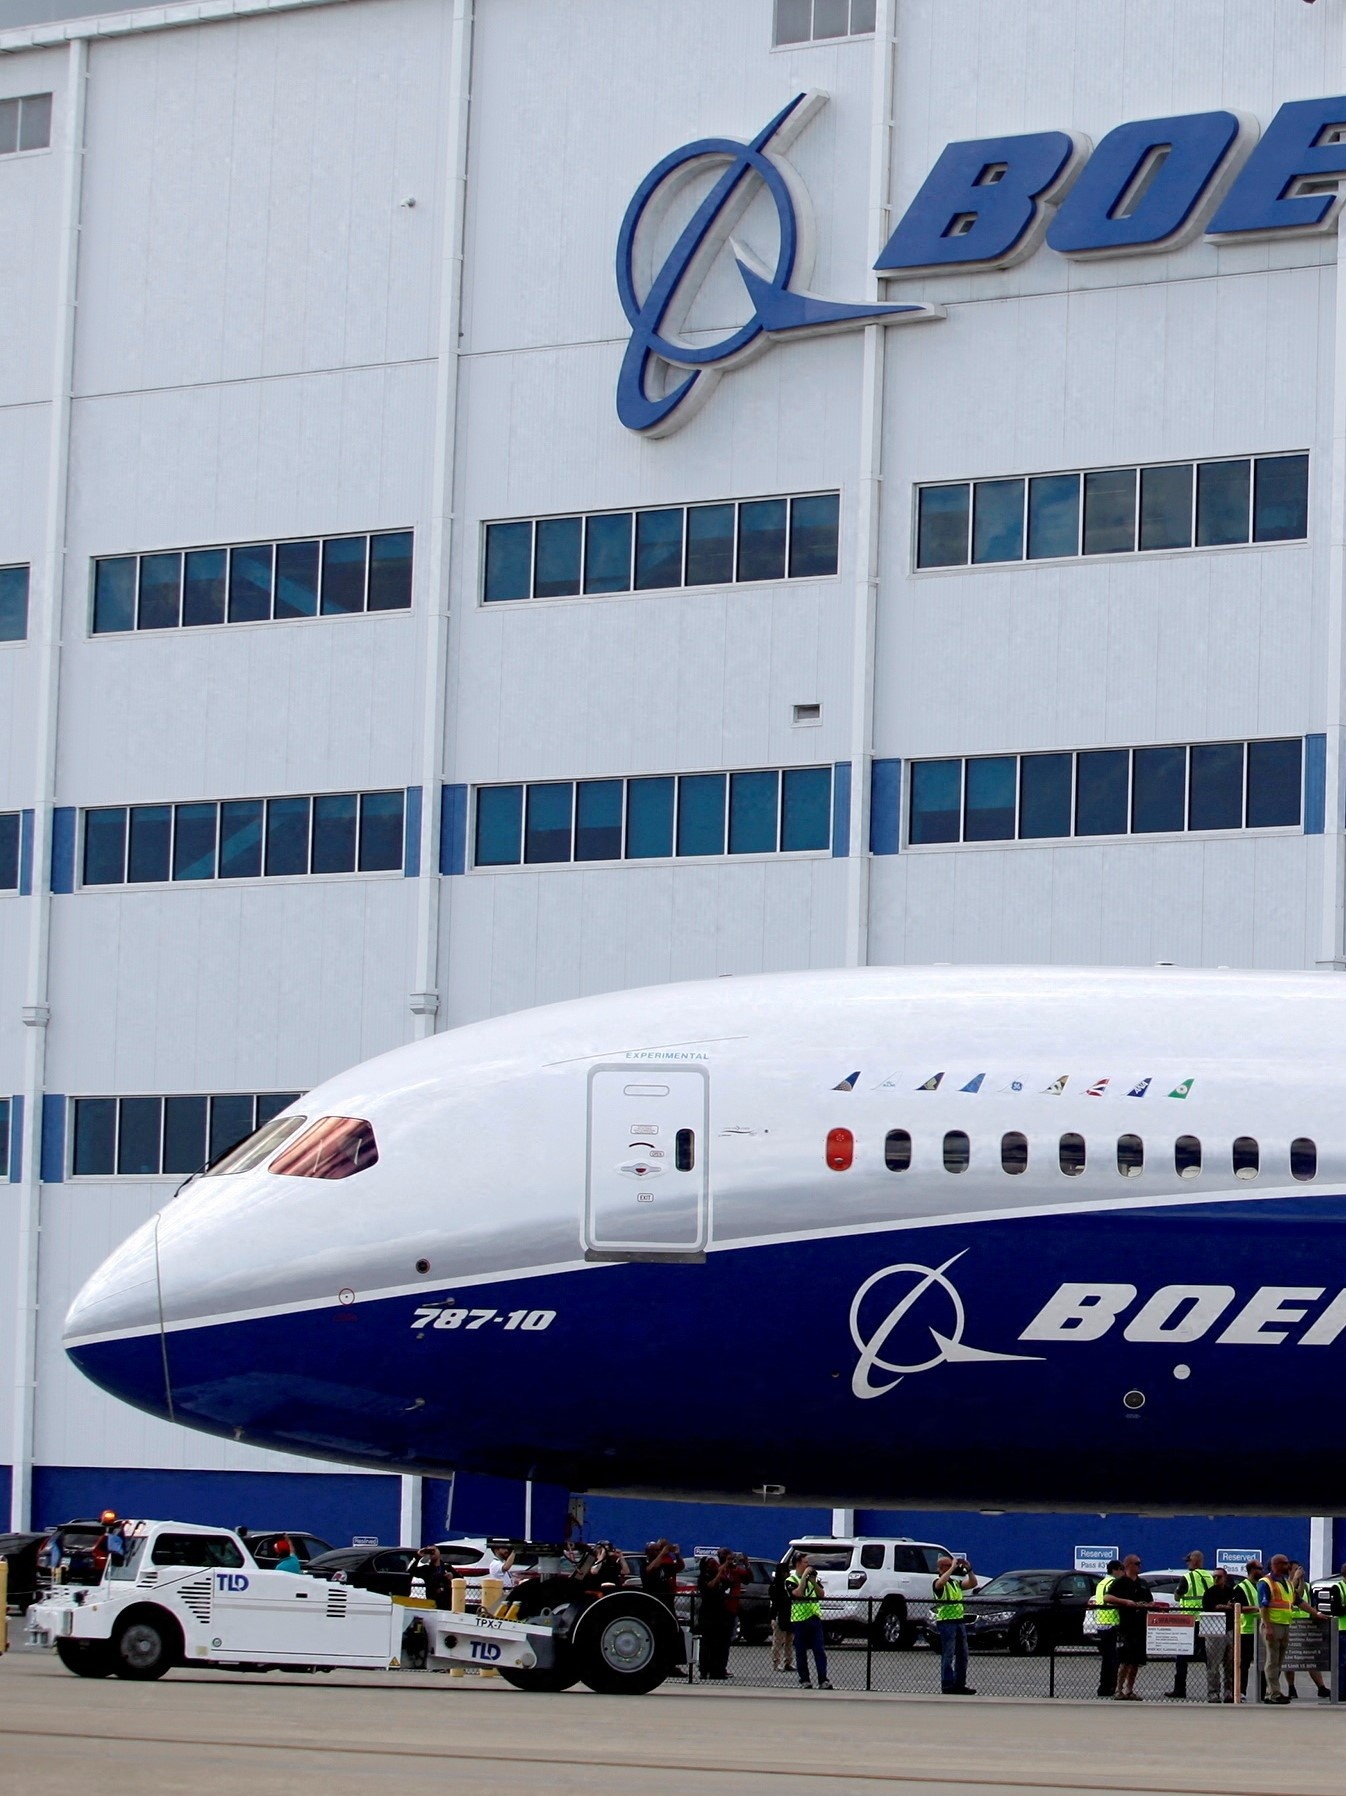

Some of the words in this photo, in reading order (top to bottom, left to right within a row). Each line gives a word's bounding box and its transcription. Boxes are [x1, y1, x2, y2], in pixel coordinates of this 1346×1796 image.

[625, 1052, 710, 1060] EXPERIMENTAL
[410, 1308, 557, 1331] 787-10
[1080, 1549, 1114, 1558] Reserved
[1222, 1552, 1257, 1562] Reserved
[216, 1573, 250, 1592] TLD
[475, 1617, 503, 1629] TPX-7
[470, 1640, 501, 1661] TLD
